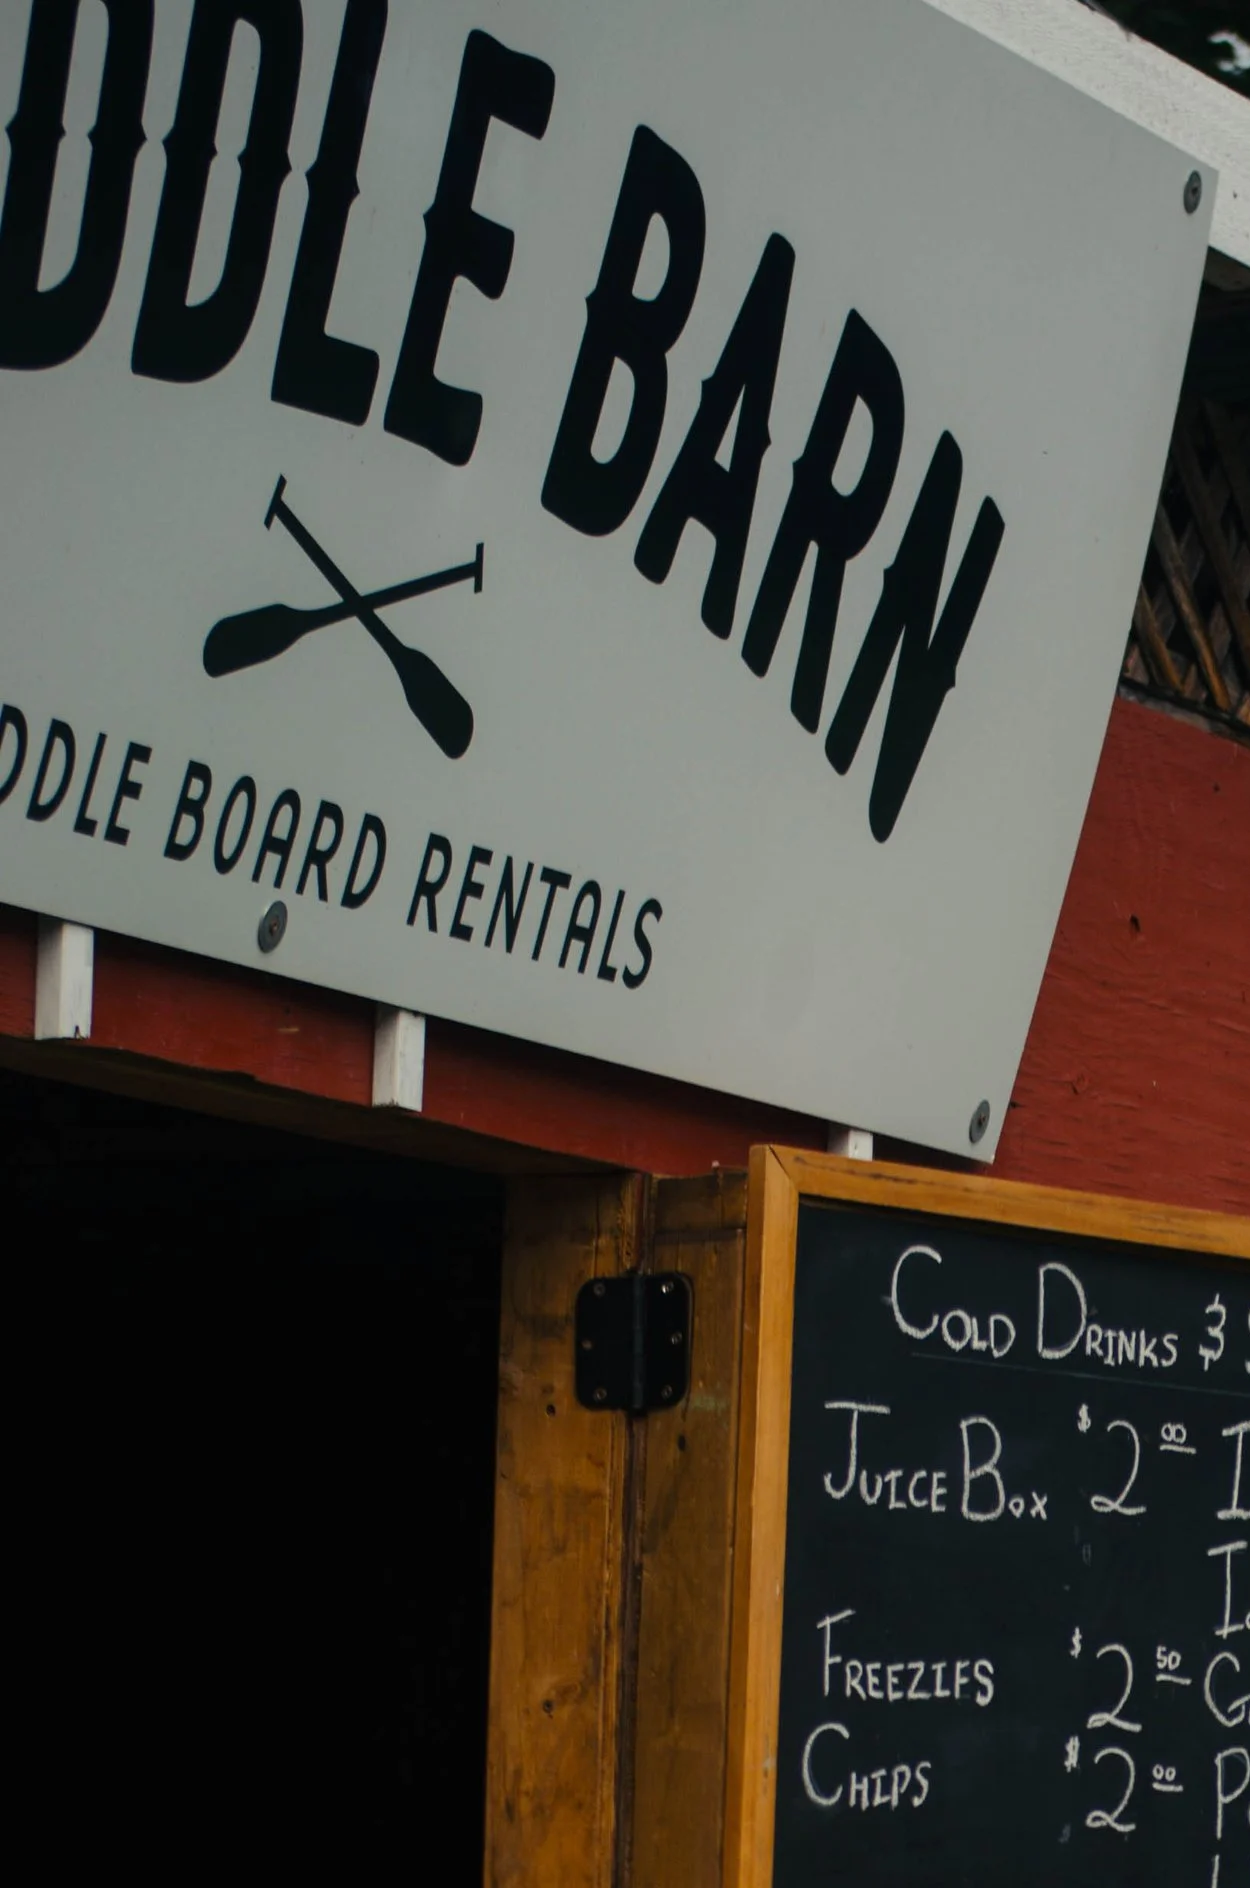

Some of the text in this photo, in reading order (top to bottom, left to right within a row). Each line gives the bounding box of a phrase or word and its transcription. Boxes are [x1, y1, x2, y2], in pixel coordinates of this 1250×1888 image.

[541, 124, 1005, 843] BARN
[163, 759, 388, 910] BOARD
[406, 832, 663, 990] RENTALS
[887, 1244, 1017, 1359] COLD
[1036, 1262, 1179, 1368] DRINKS
[802, 1722, 932, 1811] CHIPS
